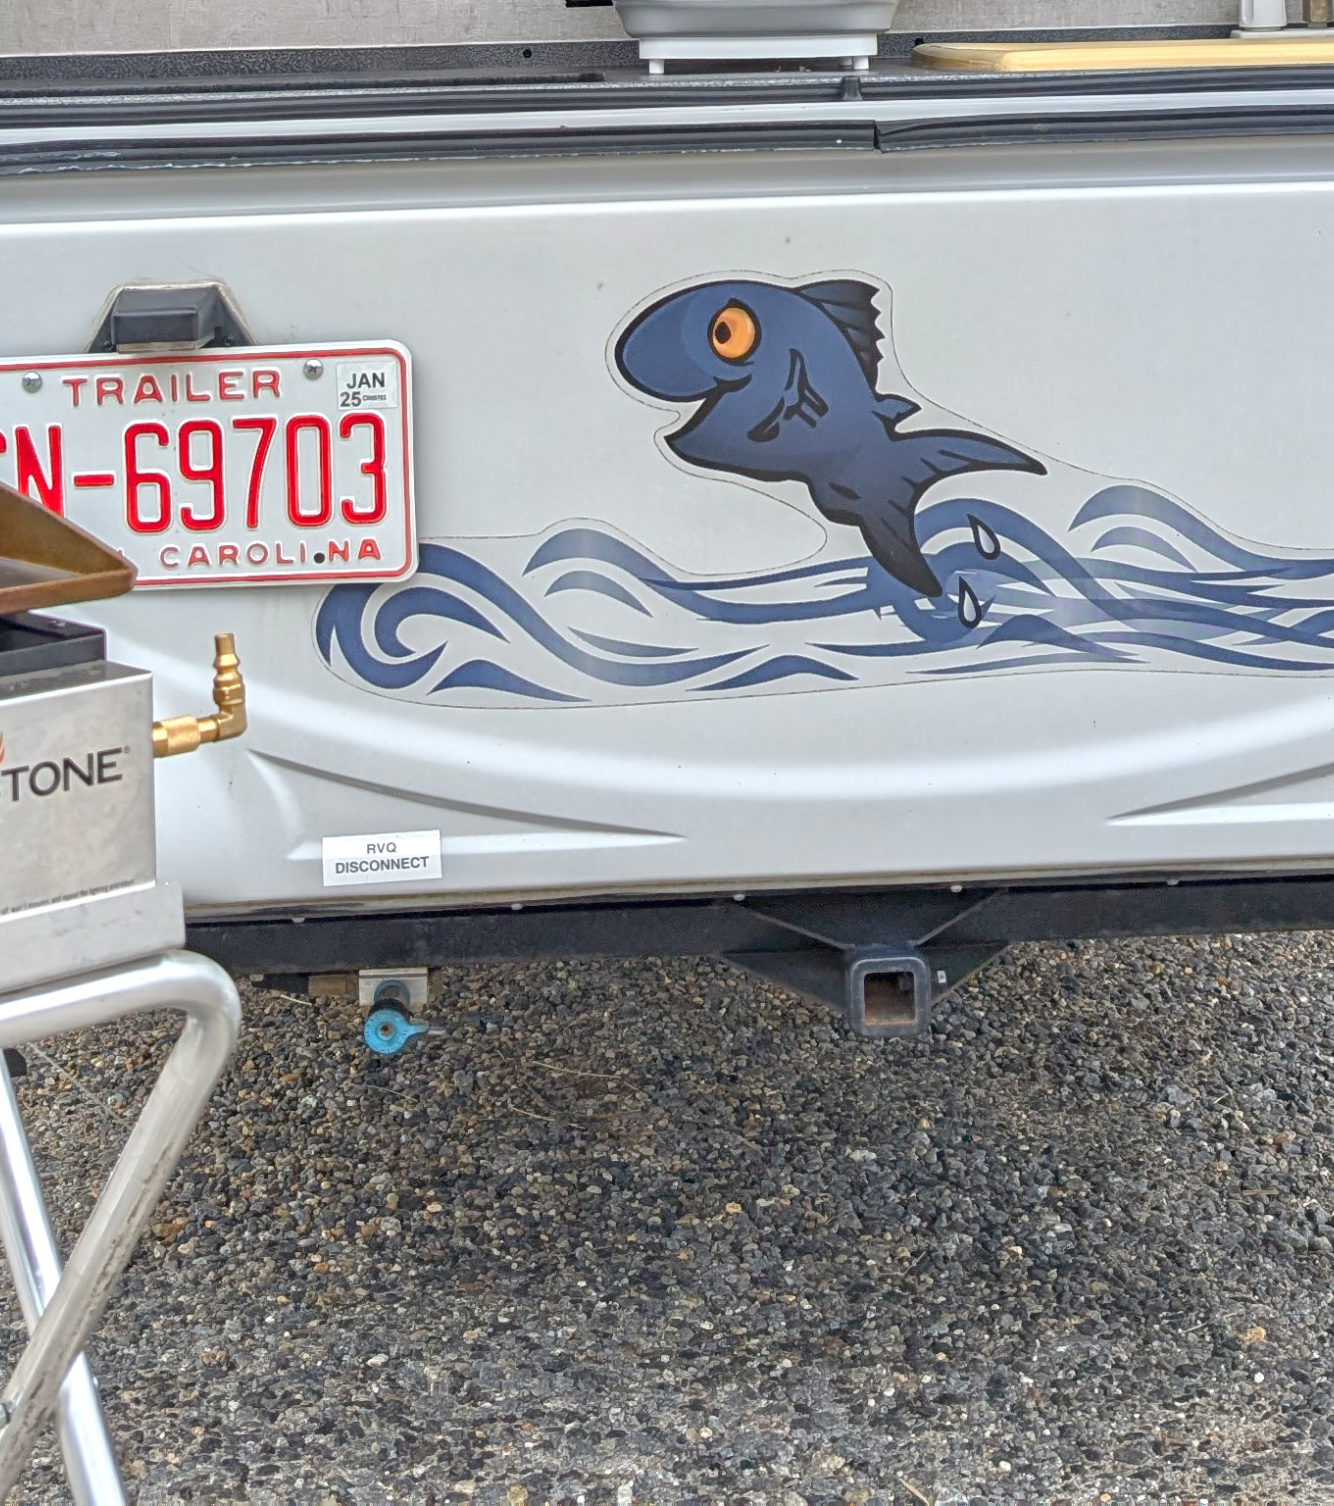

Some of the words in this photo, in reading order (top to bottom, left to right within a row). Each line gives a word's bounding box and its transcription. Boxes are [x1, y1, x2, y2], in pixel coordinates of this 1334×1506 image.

[63, 369, 281, 406] TRAILER
[347, 372, 385, 389] JAN
[340, 391, 362, 407] 25
[160, 538, 382, 569] CAROLINA
[367, 841, 397, 855] RVQ
[335, 856, 429, 874] DISCONNECT
